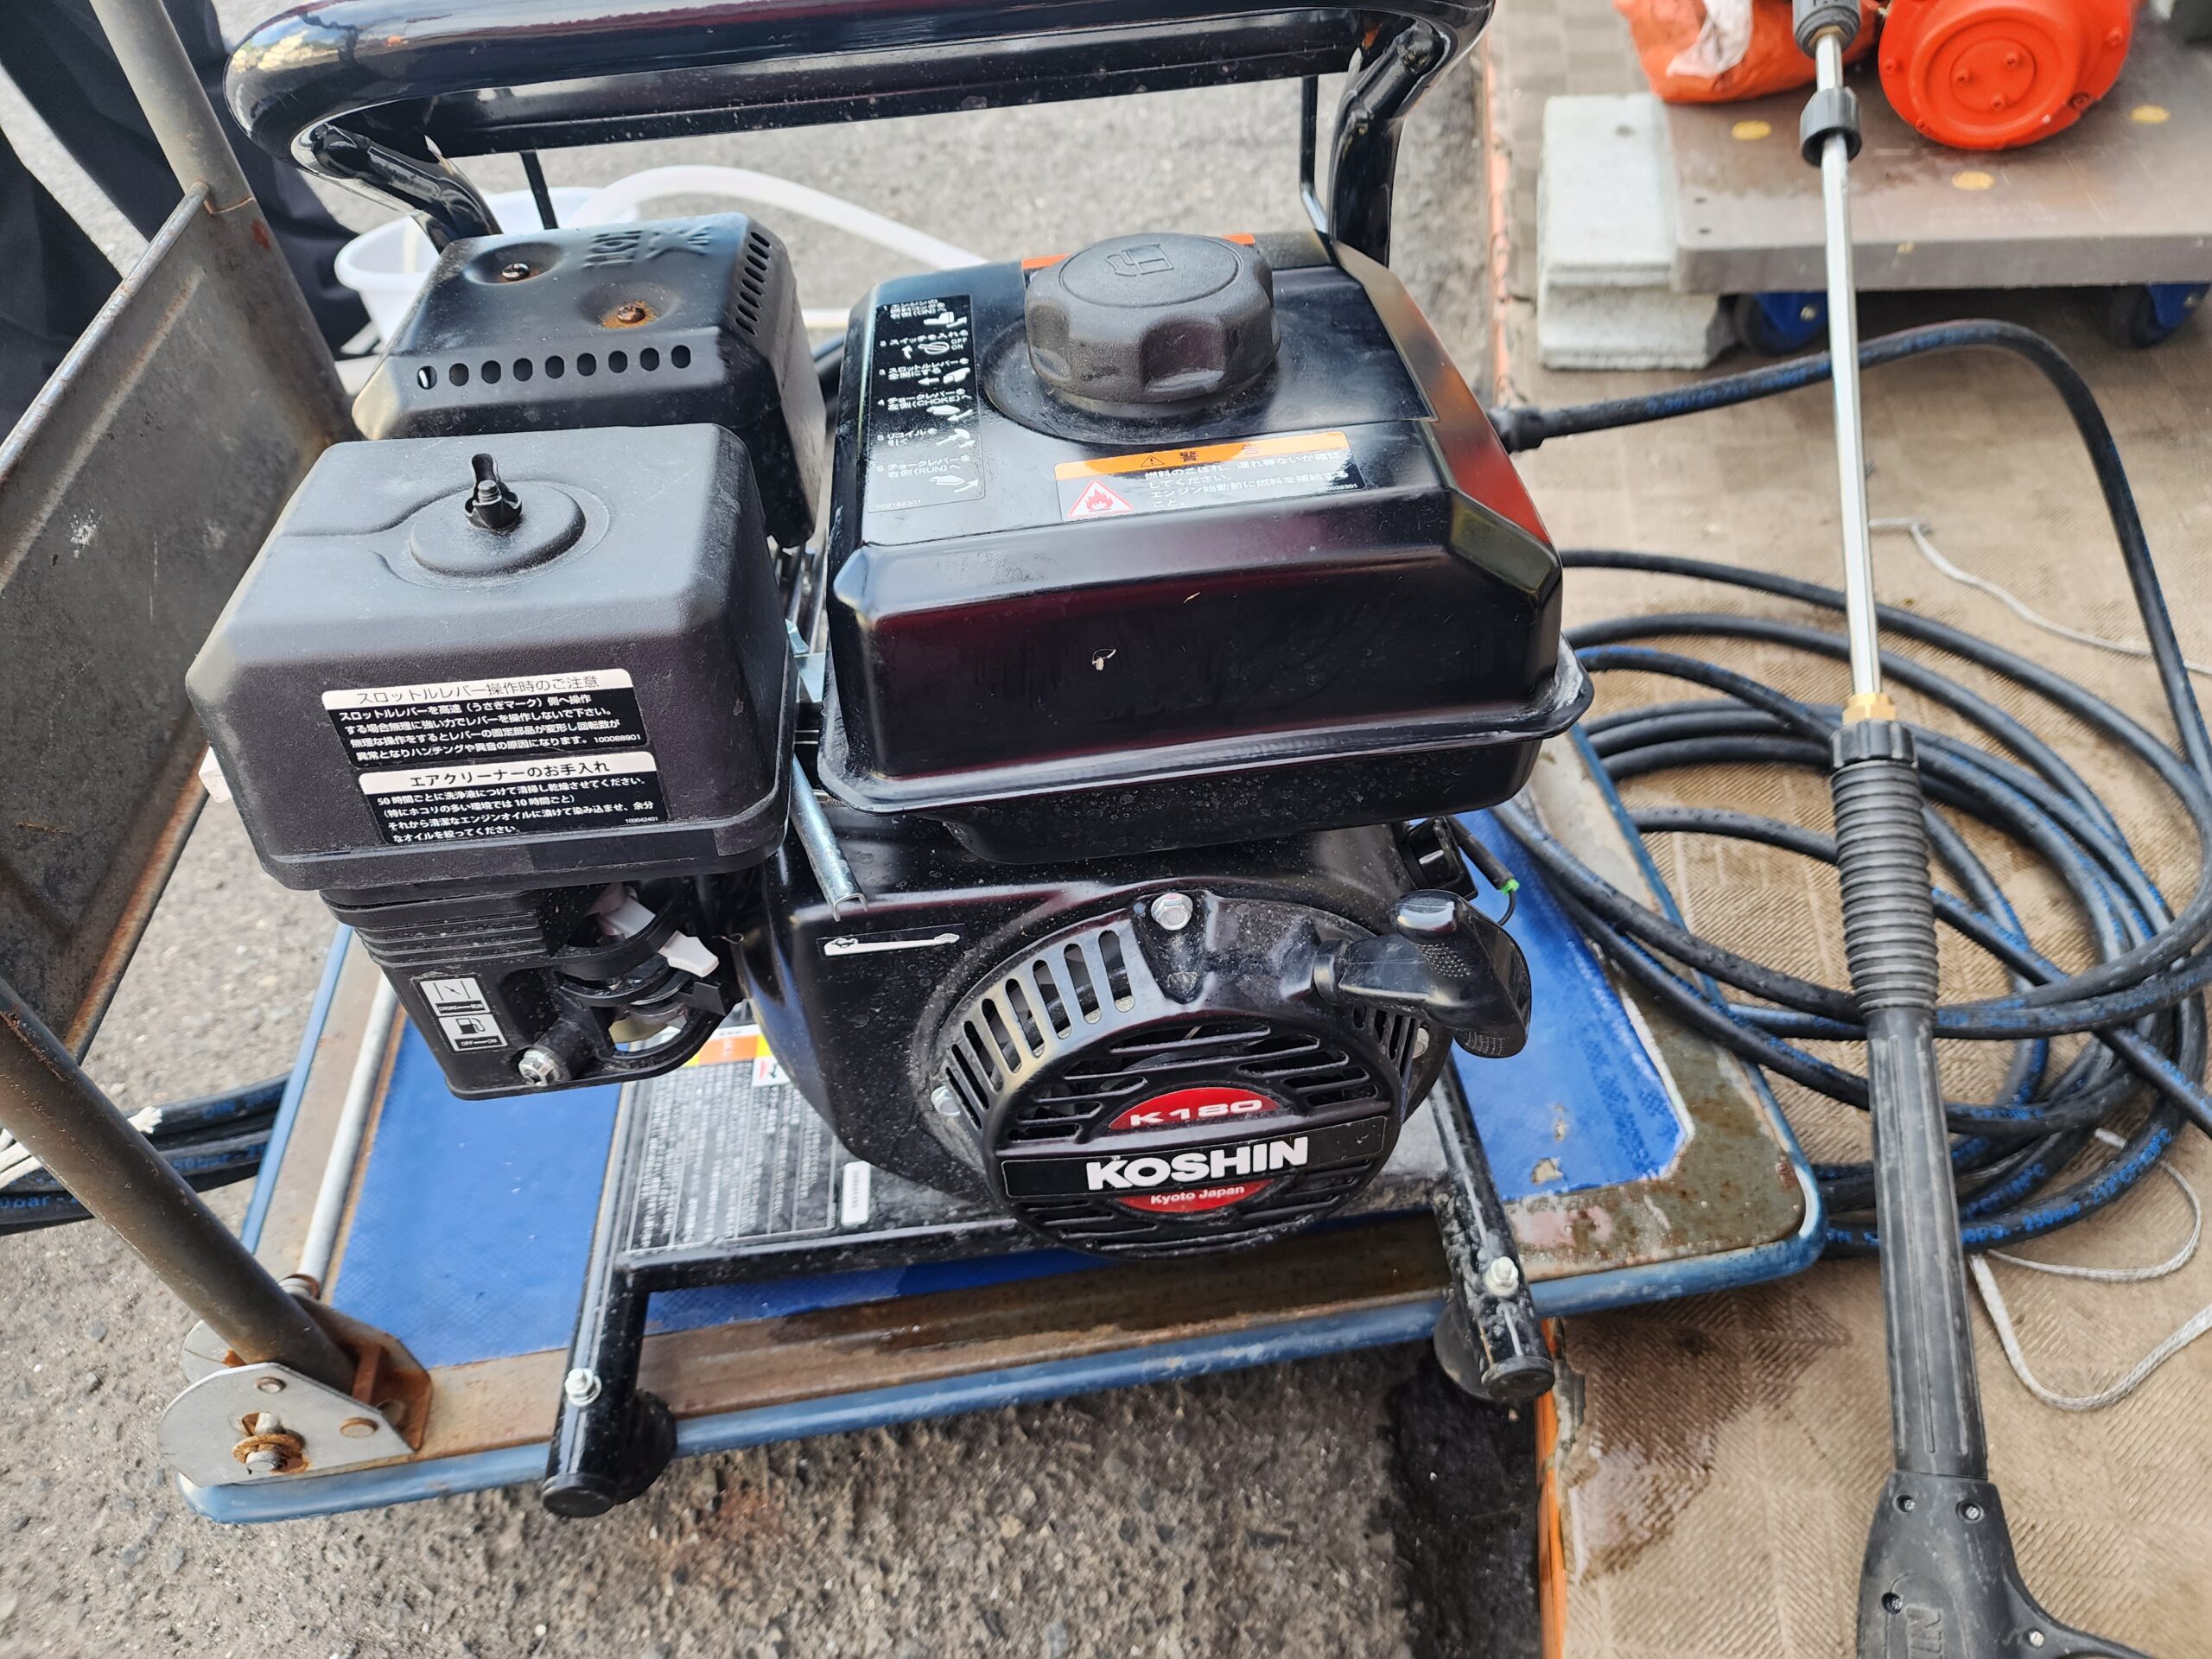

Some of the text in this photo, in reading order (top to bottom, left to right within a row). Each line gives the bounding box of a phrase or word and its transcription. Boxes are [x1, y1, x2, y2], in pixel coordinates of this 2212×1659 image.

[356, 674, 601, 705] スロットルレバー操作時のご注意
[410, 760, 610, 787] エアクリーナーのお手入れ
[1129, 1099, 1262, 1128] K180
[1086, 1136, 1309, 1191] KOSHIN
[1151, 1184, 1245, 1206] Kyoto Japan
